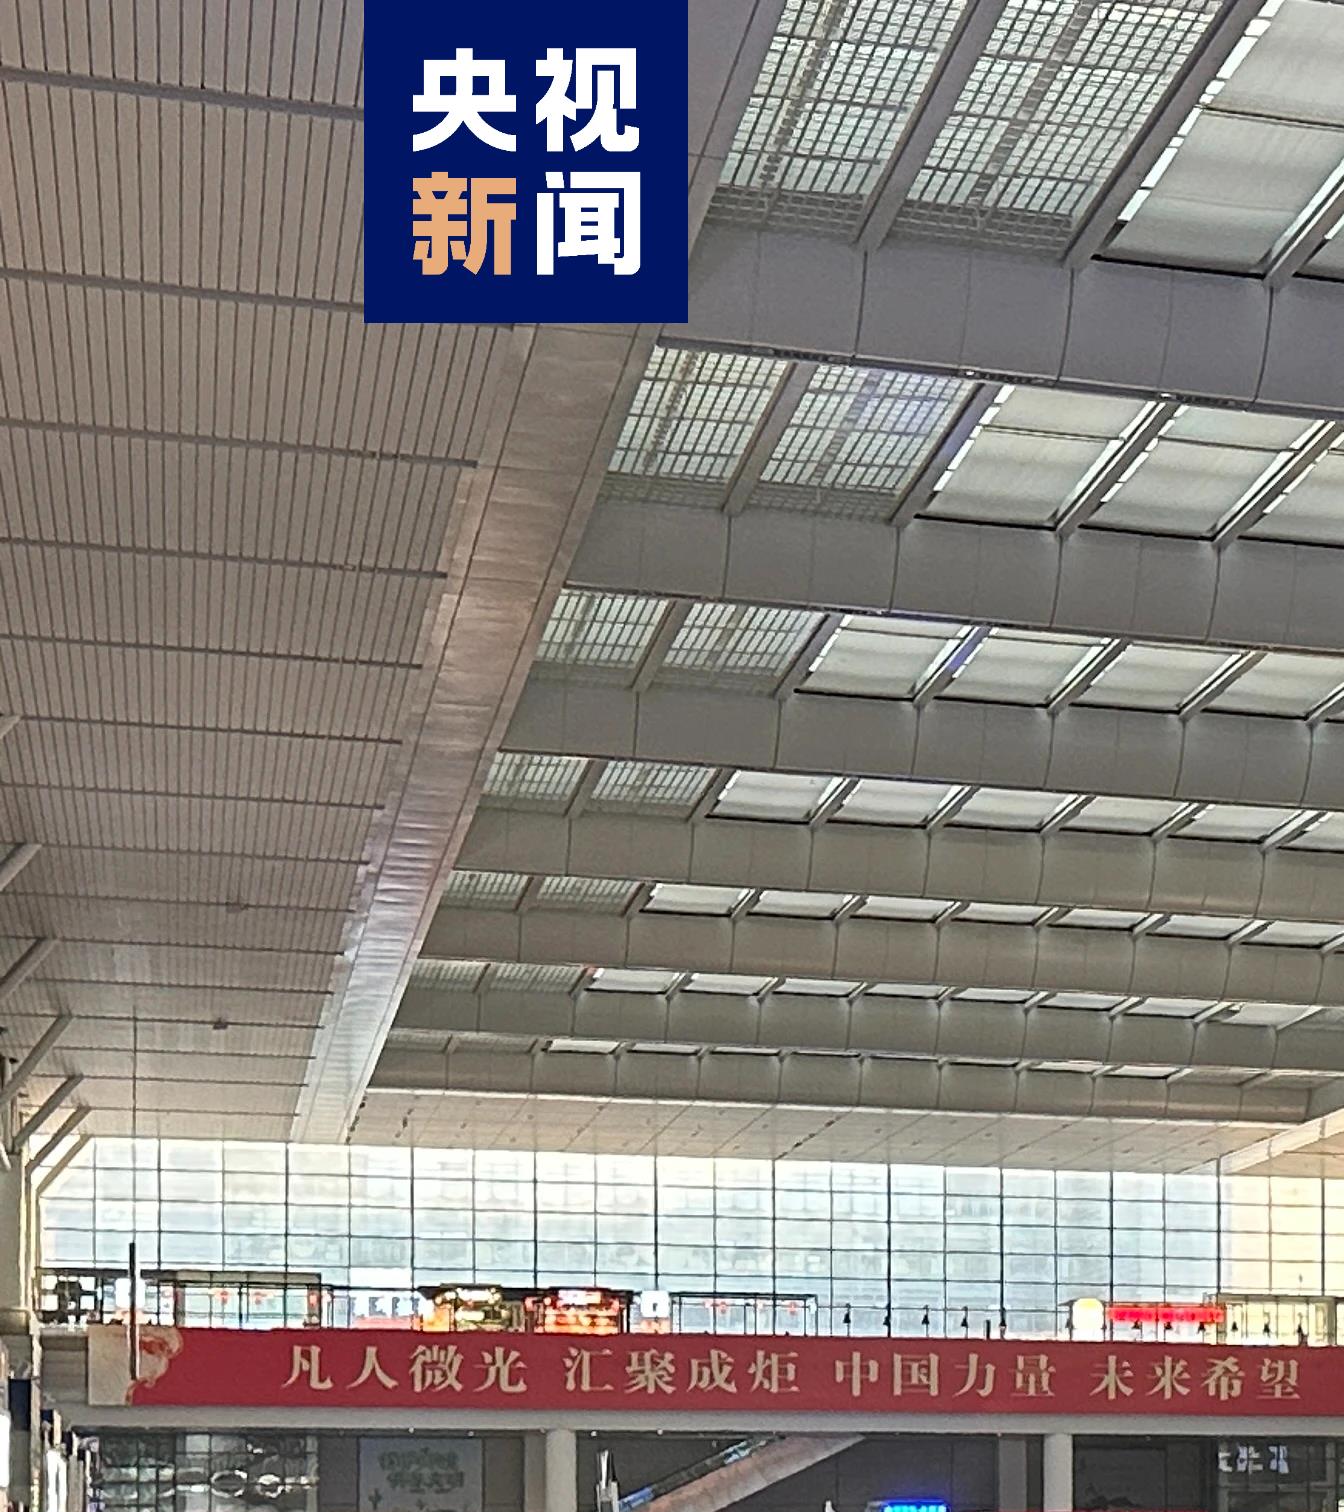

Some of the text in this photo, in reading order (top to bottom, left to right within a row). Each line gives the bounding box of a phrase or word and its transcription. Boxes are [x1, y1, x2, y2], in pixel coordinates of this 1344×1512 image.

[282, 1345, 1301, 1401] 凡人微光 汇聚成炬 中国力量 未来希望
